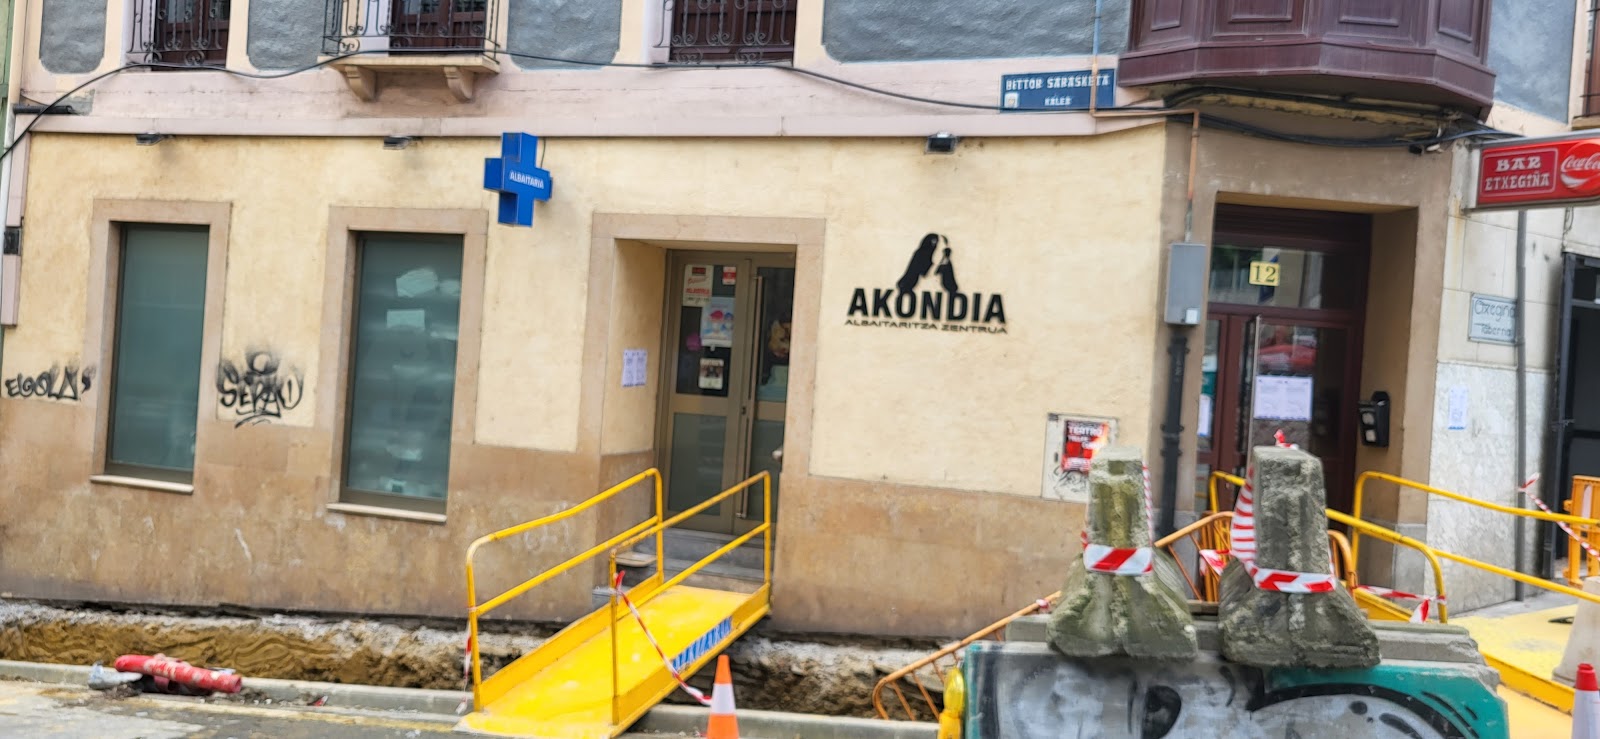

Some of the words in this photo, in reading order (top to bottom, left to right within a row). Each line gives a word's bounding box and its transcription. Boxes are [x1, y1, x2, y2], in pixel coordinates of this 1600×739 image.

[1495, 156, 1542, 172] BAR
[509, 171, 544, 189] ALBAITARIA
[1484, 170, 1550, 191] ETXEGIÑA
[1254, 265, 1276, 283] 12
[847, 287, 1006, 324] AKONDIA
[845, 319, 937, 330] ALBAITARITZA
[941, 325, 1007, 334] ZENTRUA
